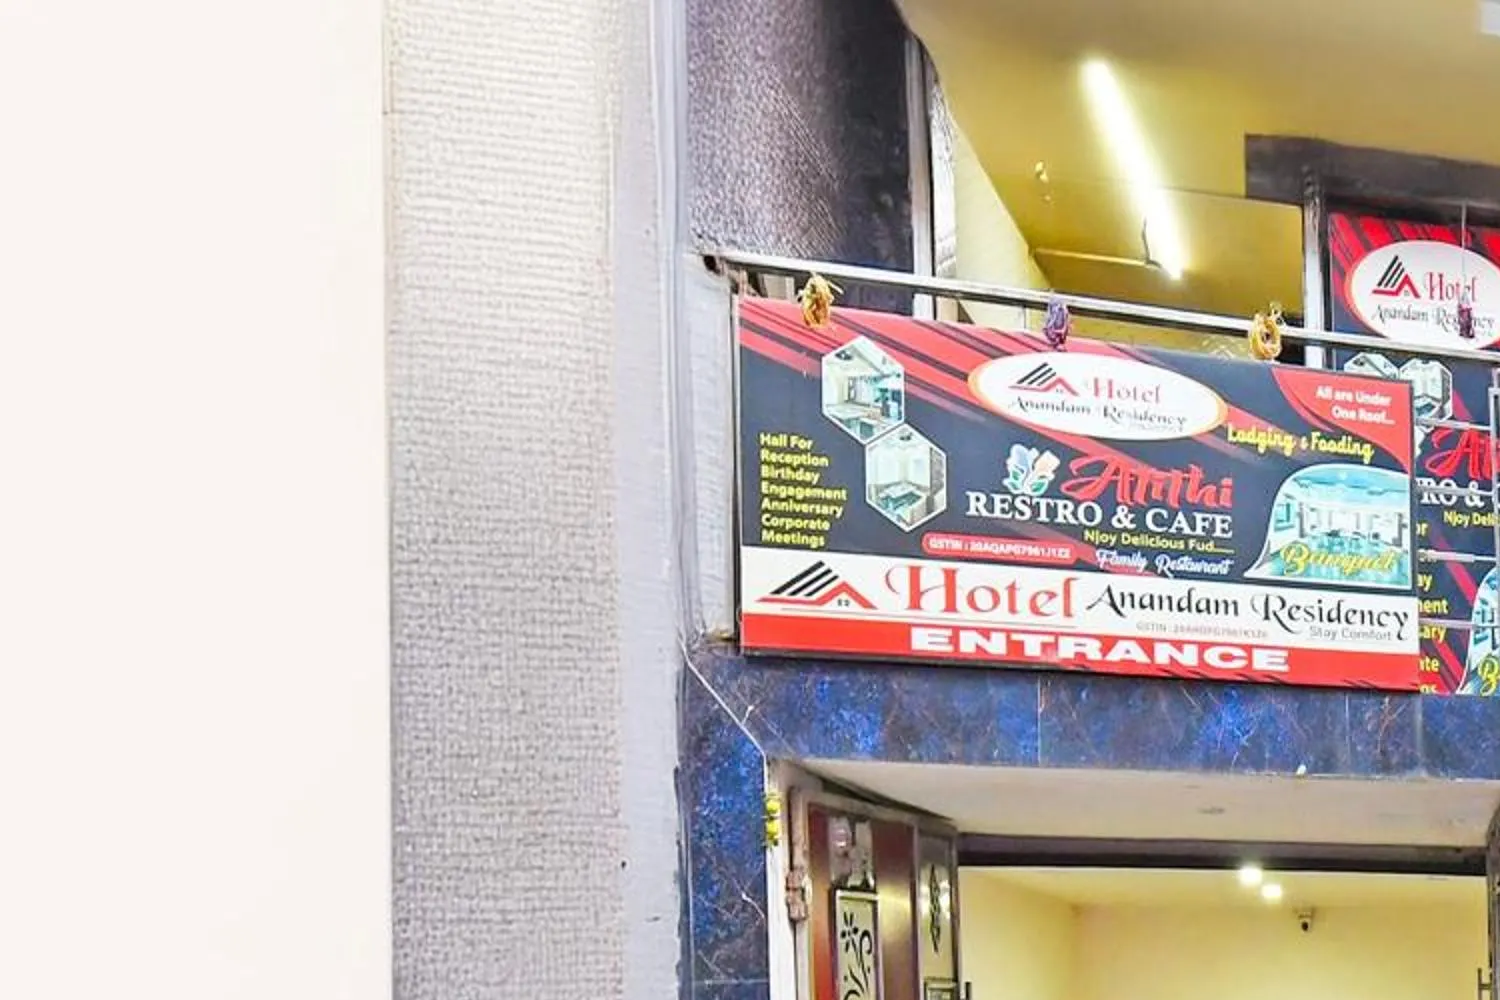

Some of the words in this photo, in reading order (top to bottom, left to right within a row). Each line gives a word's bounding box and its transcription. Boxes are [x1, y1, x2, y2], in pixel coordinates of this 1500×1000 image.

[1371, 304, 1429, 325] Anandam
[1087, 377, 1160, 404] Hotel
[1316, 386, 1332, 399] All
[1334, 389, 1353, 402] are
[1355, 390, 1392, 405] Under
[1010, 396, 1091, 415] Anandam
[1099, 404, 1187, 432] Residency
[1332, 406, 1356, 419] One
[760, 433, 787, 447] Hall
[790, 435, 814, 449] For
[1228, 424, 1296, 456] Lodging
[1311, 432, 1375, 465] Fooding
[760, 449, 829, 467] Reception
[761, 464, 820, 485] Birthday
[761, 481, 848, 500] Engagement
[761, 497, 844, 519] Anniversary
[965, 491, 1103, 527] RESTRO
[1111, 505, 1136, 529] &
[1145, 507, 1233, 538] CAFE
[761, 513, 830, 531] Corporate
[761, 529, 826, 550] Meetings
[1084, 530, 1117, 546] Njoy
[1121, 534, 1185, 549] Delicious
[1095, 549, 1147, 573] Family
[1154, 553, 1234, 579] Restaurant
[885, 565, 1080, 618] Hotel
[1086, 584, 1239, 618] Anandam
[1250, 593, 1410, 641] Residency
[1309, 625, 1337, 641] Stay
[1341, 627, 1392, 641] Comfort
[911, 626, 1290, 672] ENTRANCE
